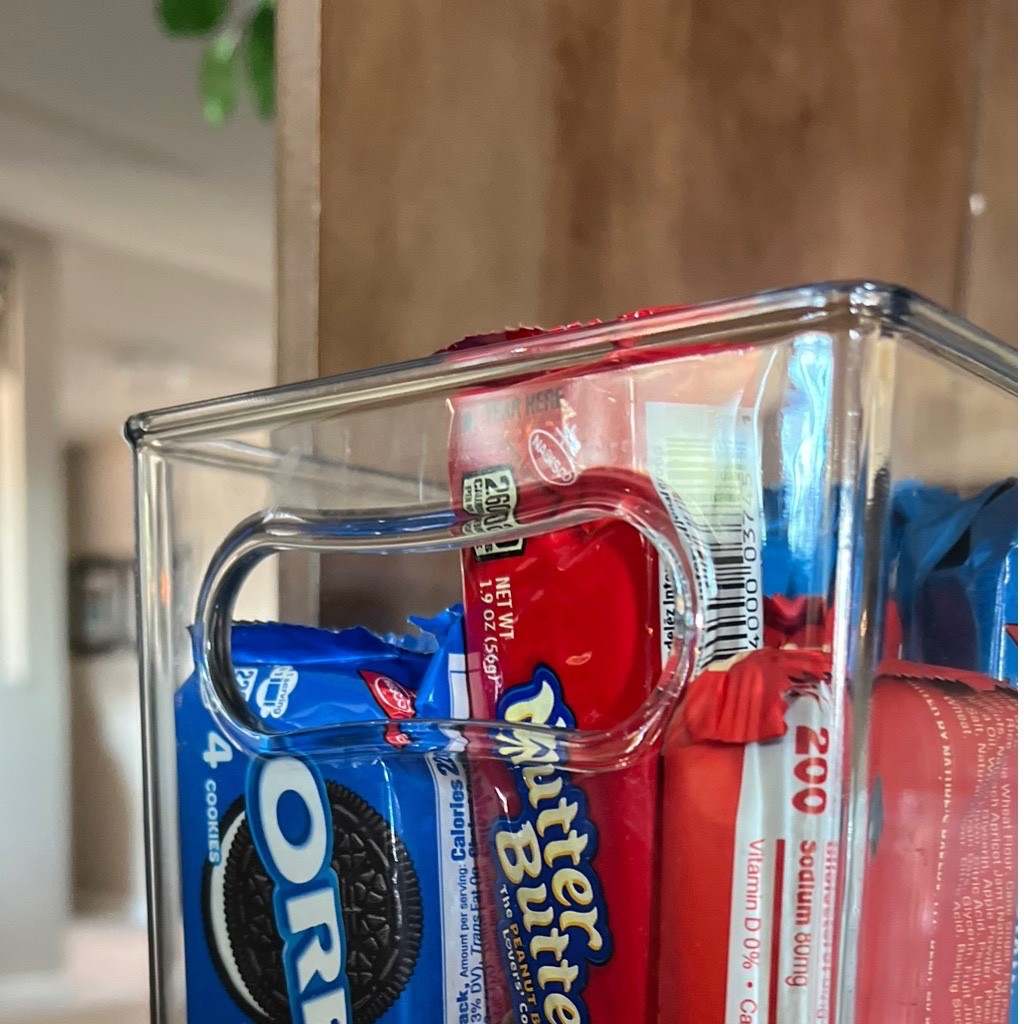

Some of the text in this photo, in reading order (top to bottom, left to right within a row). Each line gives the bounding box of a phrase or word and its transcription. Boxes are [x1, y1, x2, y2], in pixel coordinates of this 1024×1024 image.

[479, 578, 498, 682] 1.9 OZ (56g)
[496, 577, 515, 640] NET WT
[203, 732, 233, 867] 4 COOKIES
[791, 727, 830, 816] 200
[450, 779, 465, 863] Calories
[499, 680, 604, 952] Nutter
[1000, 784, 1012, 829] Wheat
[457, 864, 468, 911] serving:
[745, 838, 765, 912] Vitamin
[982, 878, 994, 921] Apple
[460, 913, 470, 932] per
[499, 884, 514, 918] The
[509, 923, 537, 1007] PEANUT
[744, 919, 762, 933] D
[785, 840, 816, 988] Sodium 80mg
[459, 934, 469, 978] Amount
[469, 960, 484, 994] DV),
[741, 939, 762, 971] 0%
